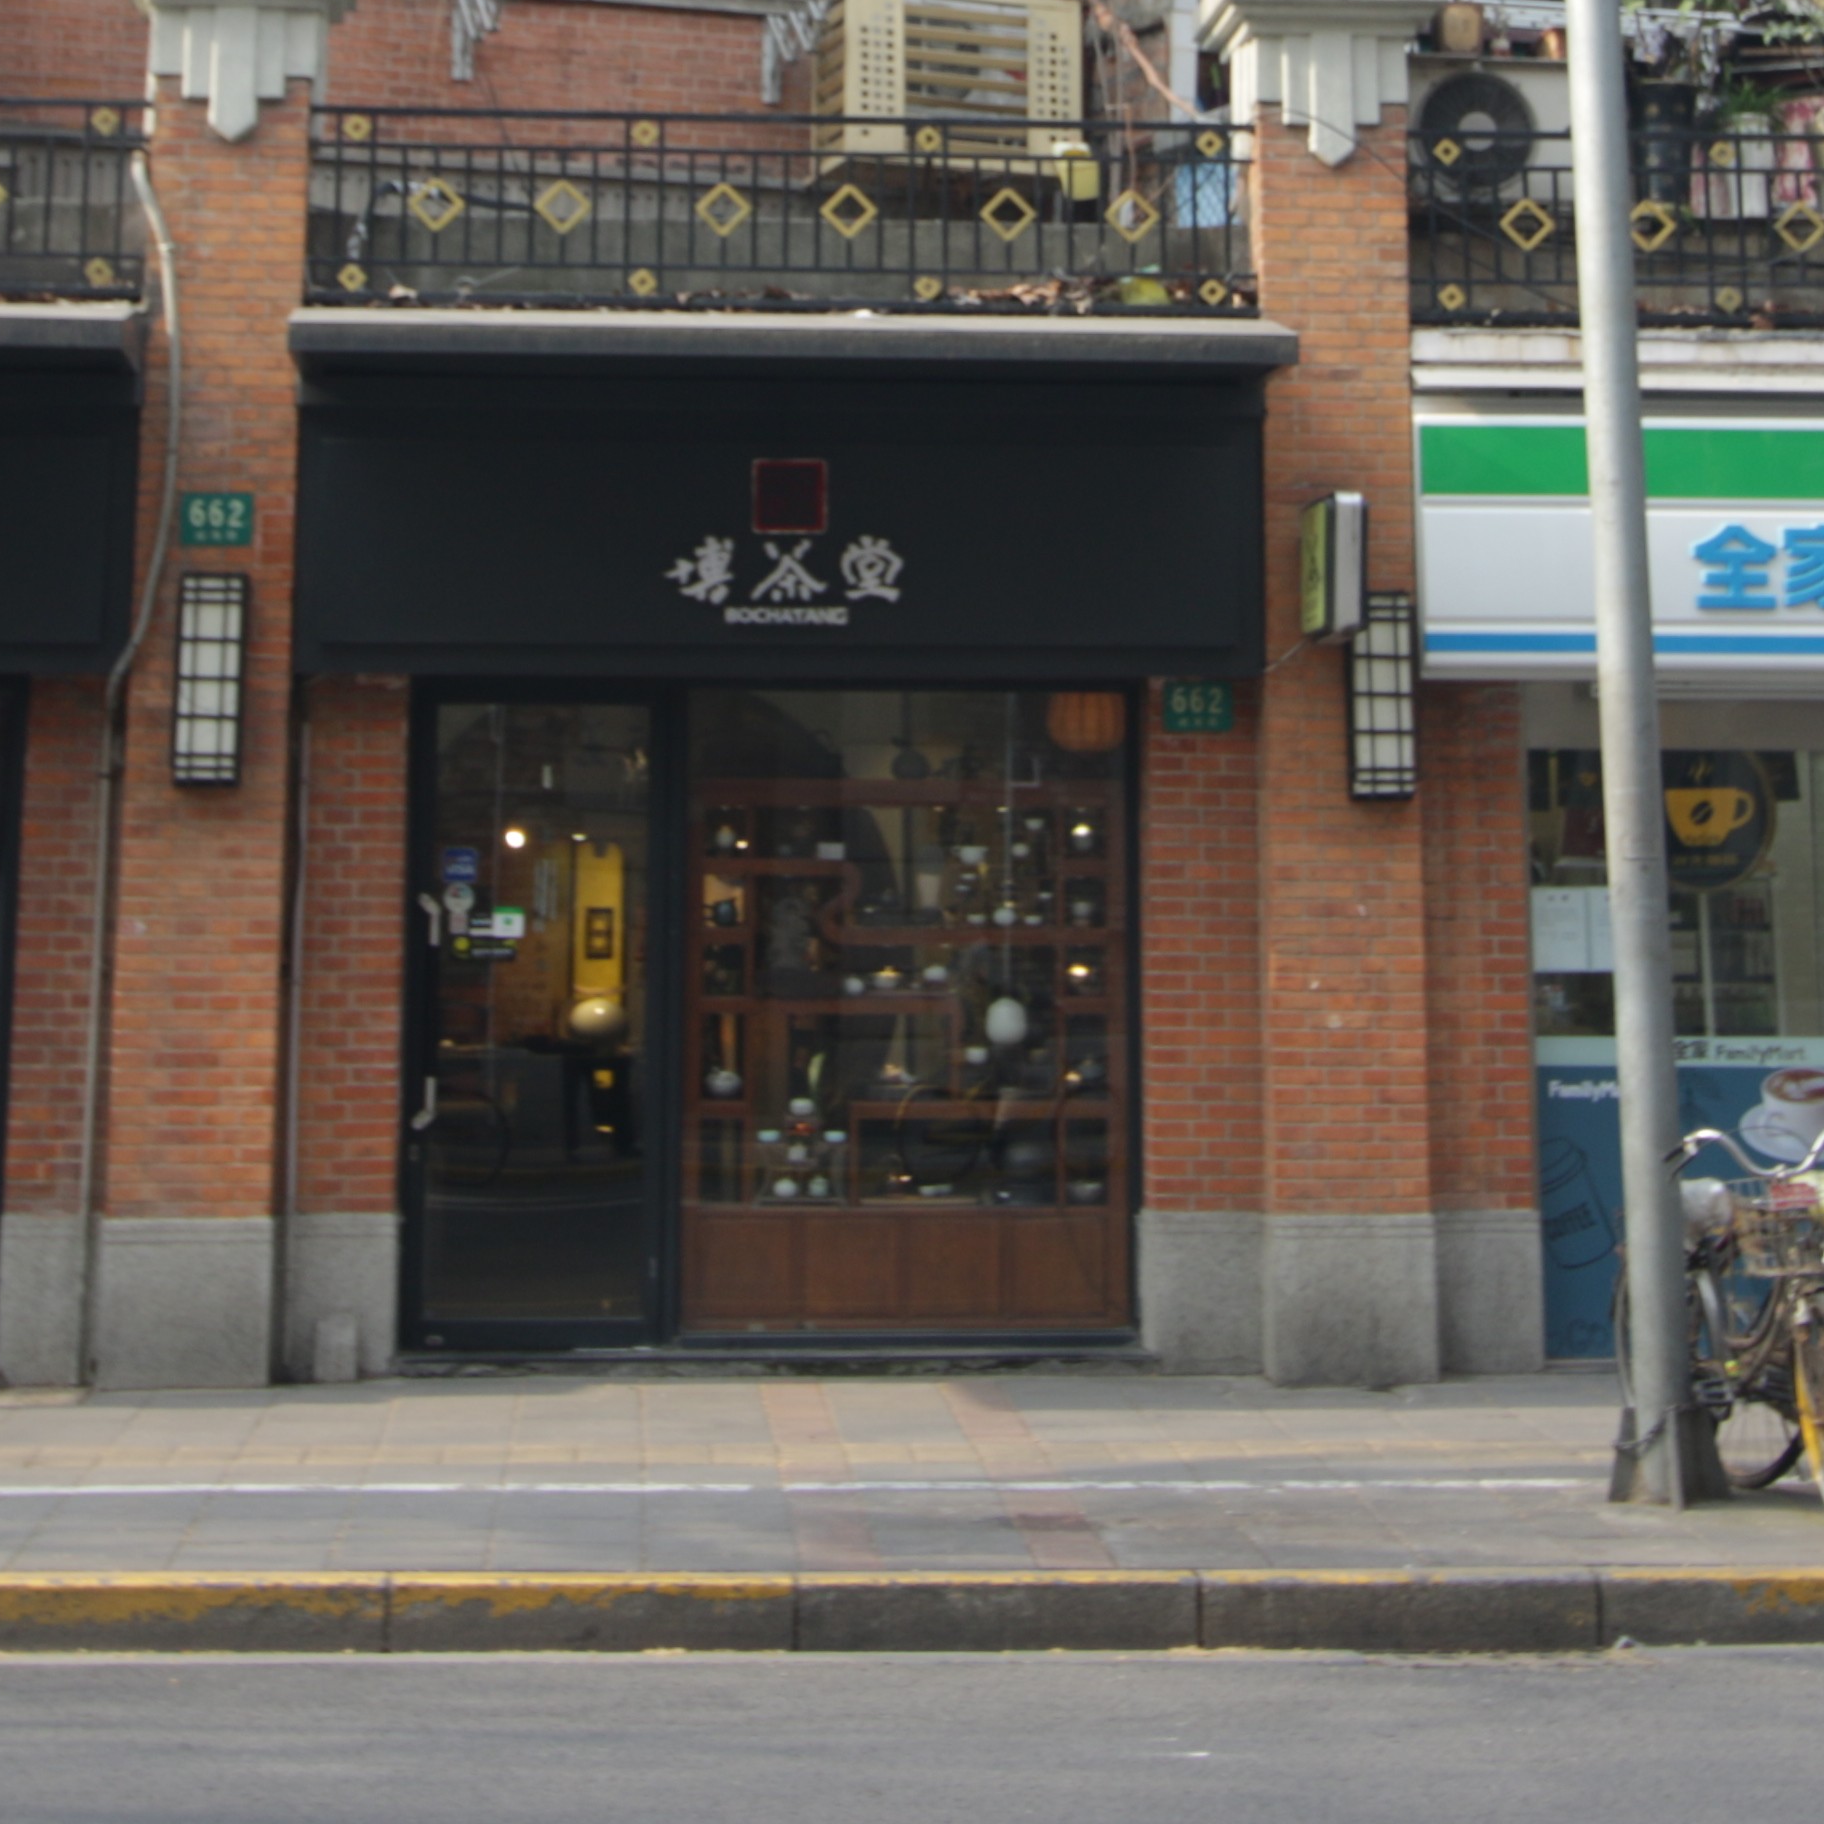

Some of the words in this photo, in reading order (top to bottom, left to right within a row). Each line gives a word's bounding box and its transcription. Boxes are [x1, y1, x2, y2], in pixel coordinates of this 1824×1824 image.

[188, 498, 245, 529] 662
[724, 607, 849, 625] BOCHATANG
[1171, 686, 1224, 714] 662
